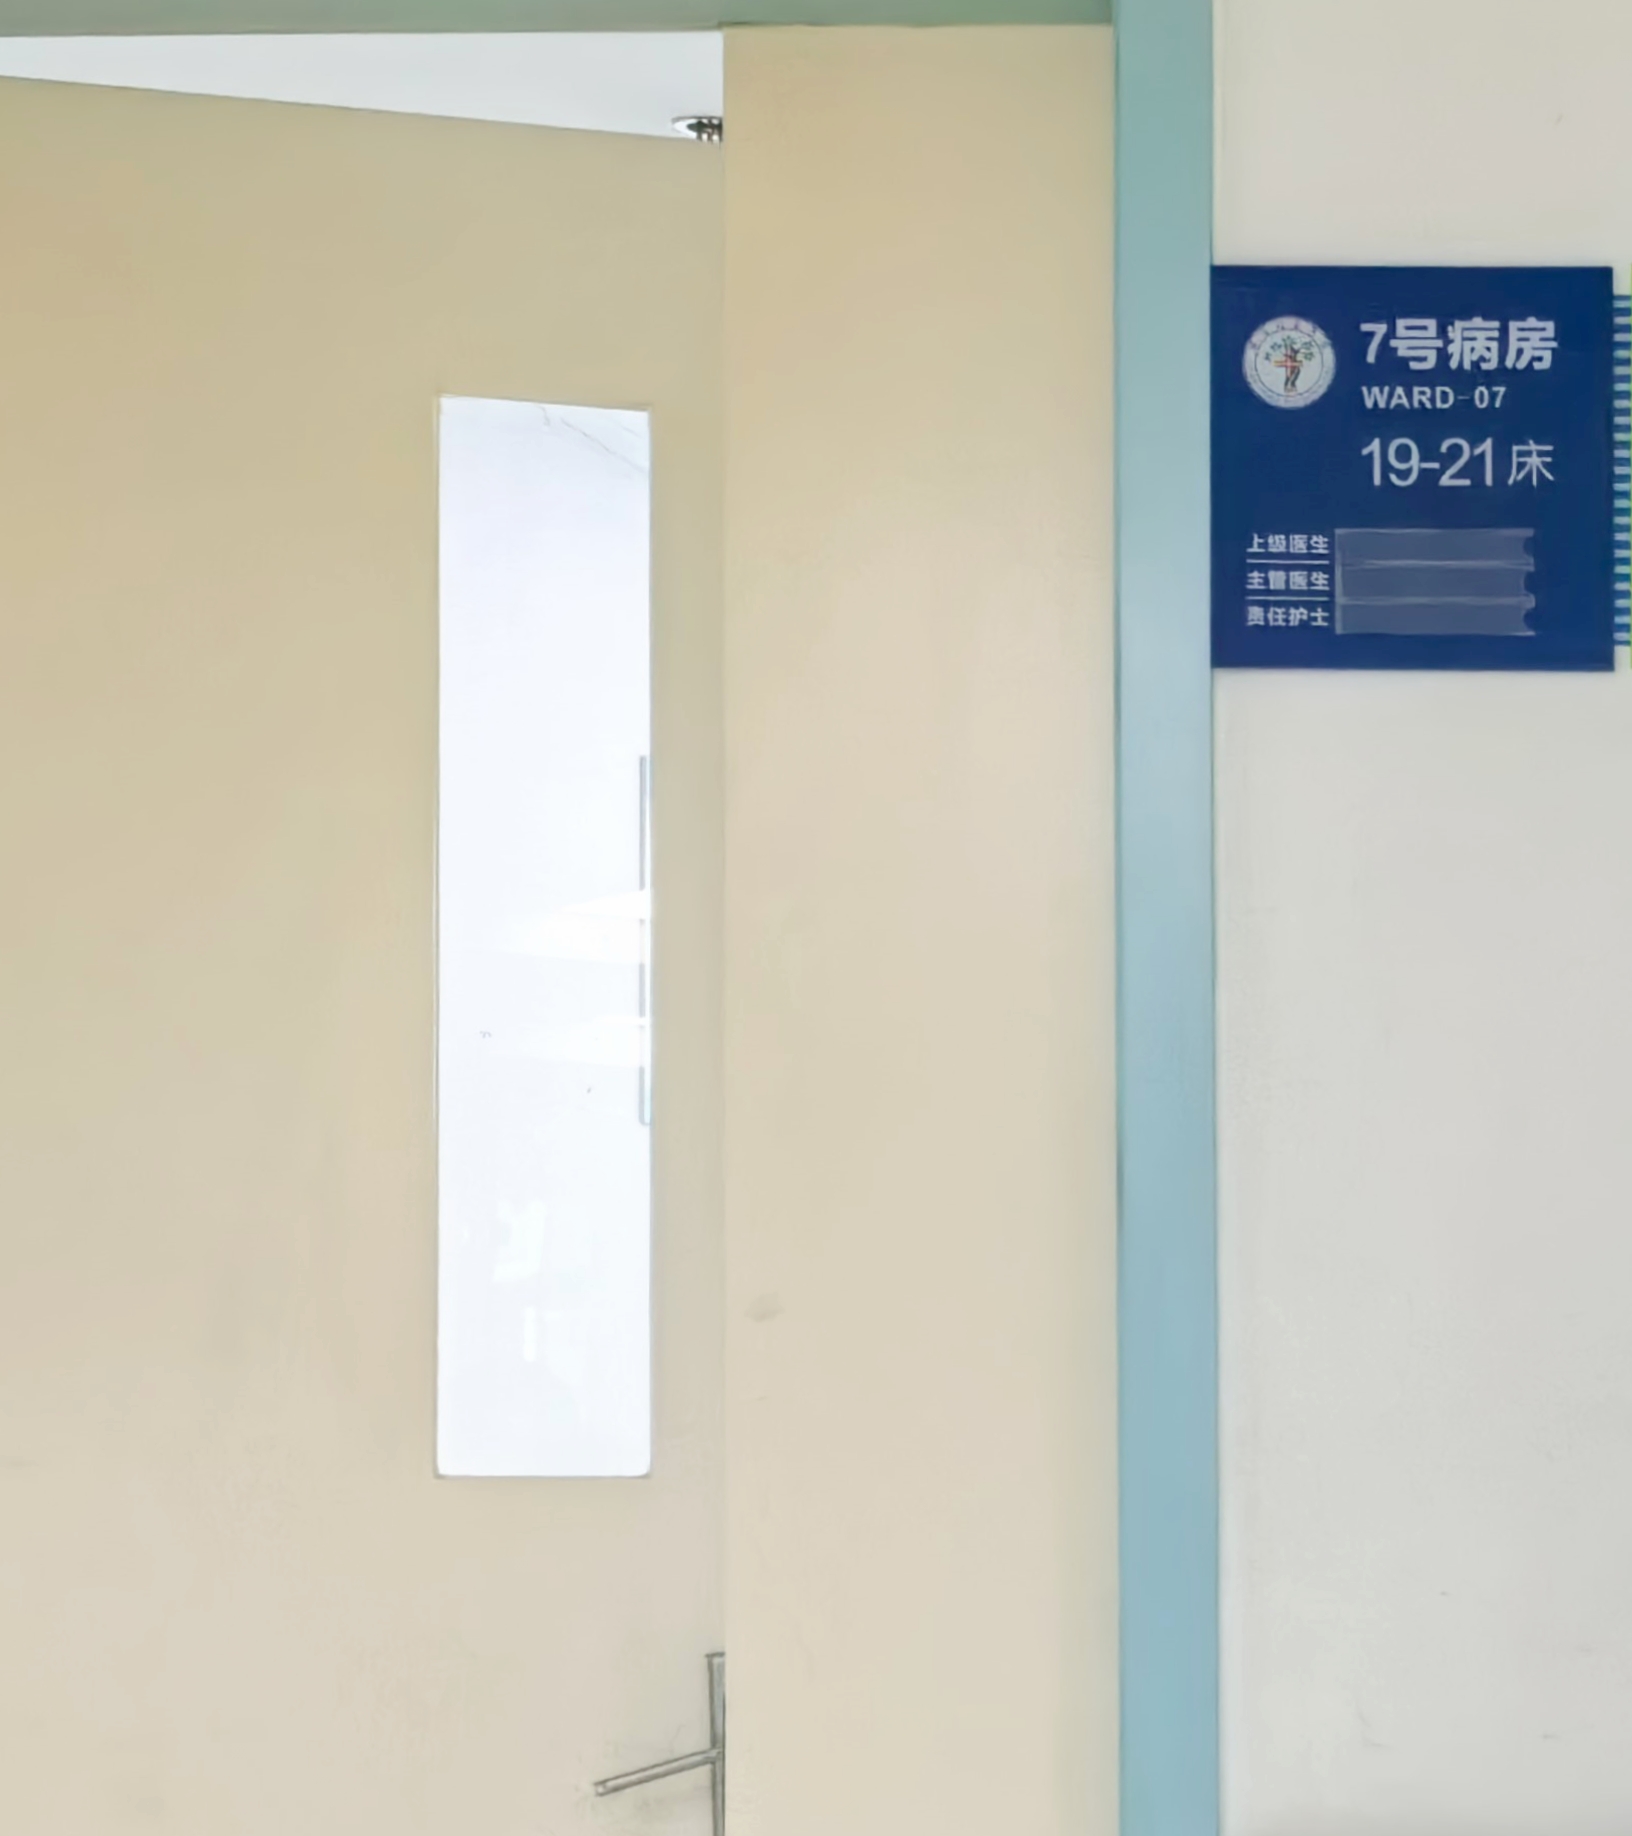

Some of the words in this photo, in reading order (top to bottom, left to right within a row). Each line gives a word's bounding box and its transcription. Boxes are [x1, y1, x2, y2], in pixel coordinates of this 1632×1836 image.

[1359, 316, 1558, 371] 7号病房
[1361, 437, 1555, 488] 19-21床
[1246, 533, 1329, 554] 上级医生
[1246, 570, 1330, 591] 主管医生
[1246, 605, 1329, 627] 责任护士
